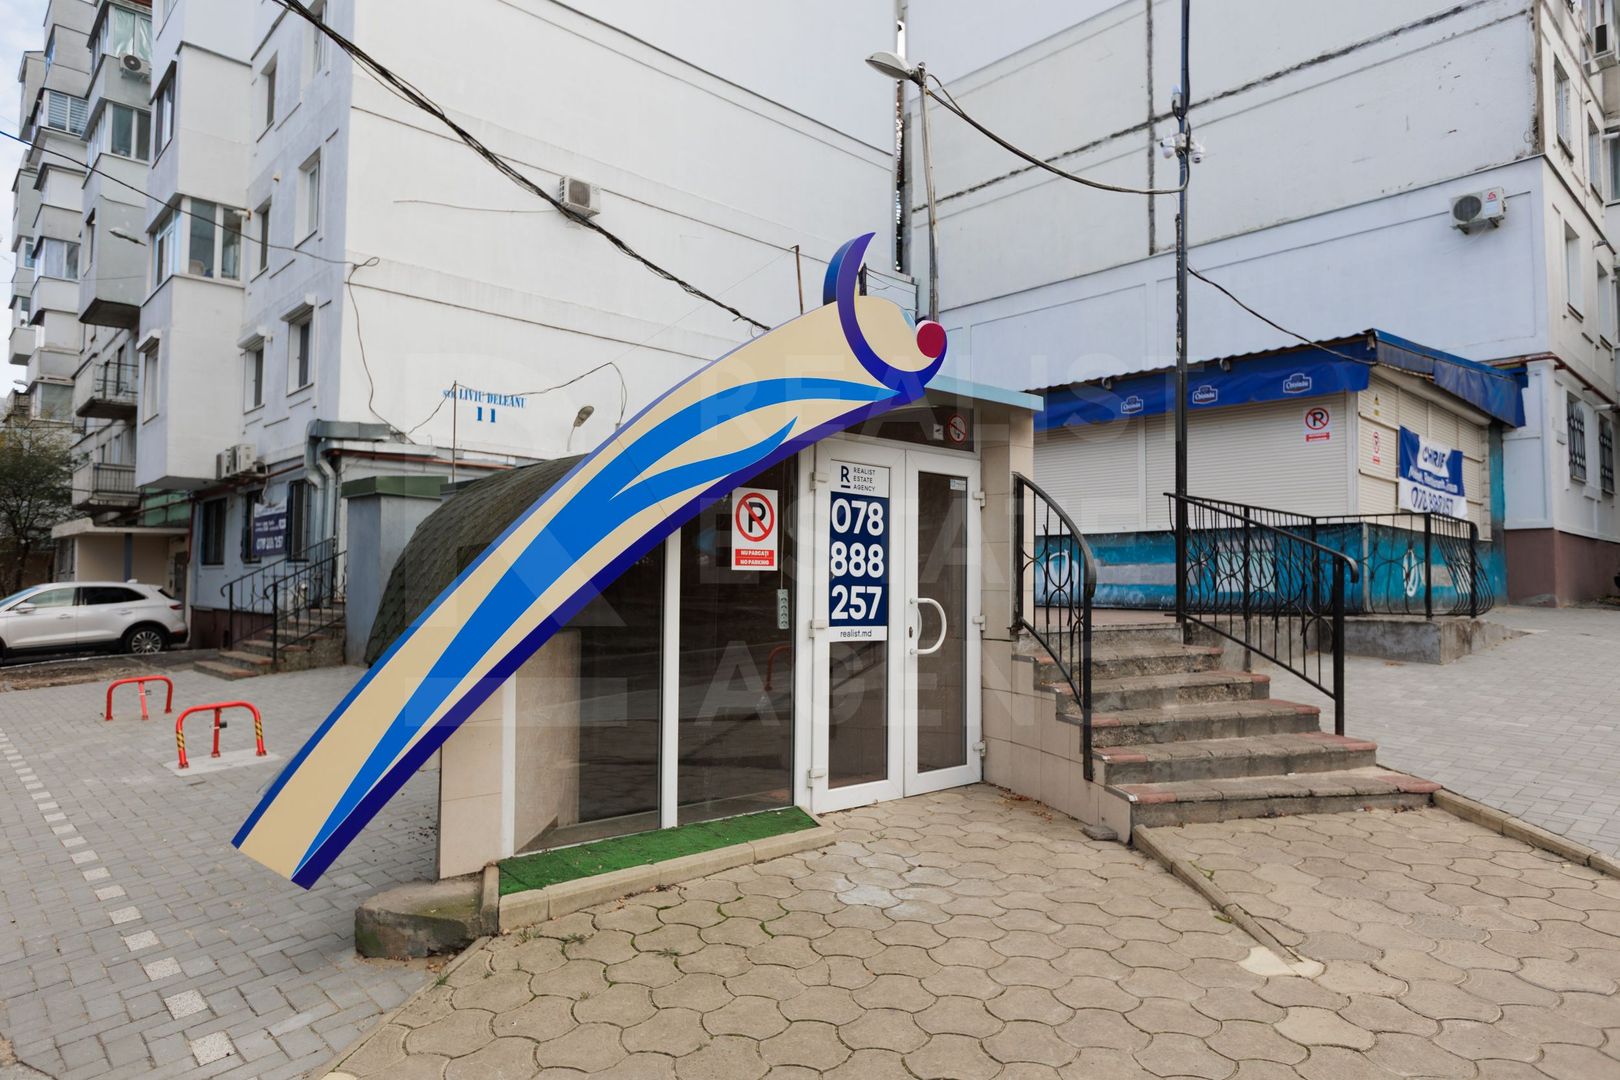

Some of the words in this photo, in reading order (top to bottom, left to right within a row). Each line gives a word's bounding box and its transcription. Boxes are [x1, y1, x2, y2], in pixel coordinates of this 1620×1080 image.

[853, 467, 875, 476] REALIST
[853, 475, 873, 484] ESTATE
[853, 484, 875, 492] AGENCY
[831, 498, 884, 537] 078
[831, 541, 884, 578] 888
[831, 584, 882, 620] 257
[840, 626, 873, 638] realist.md
